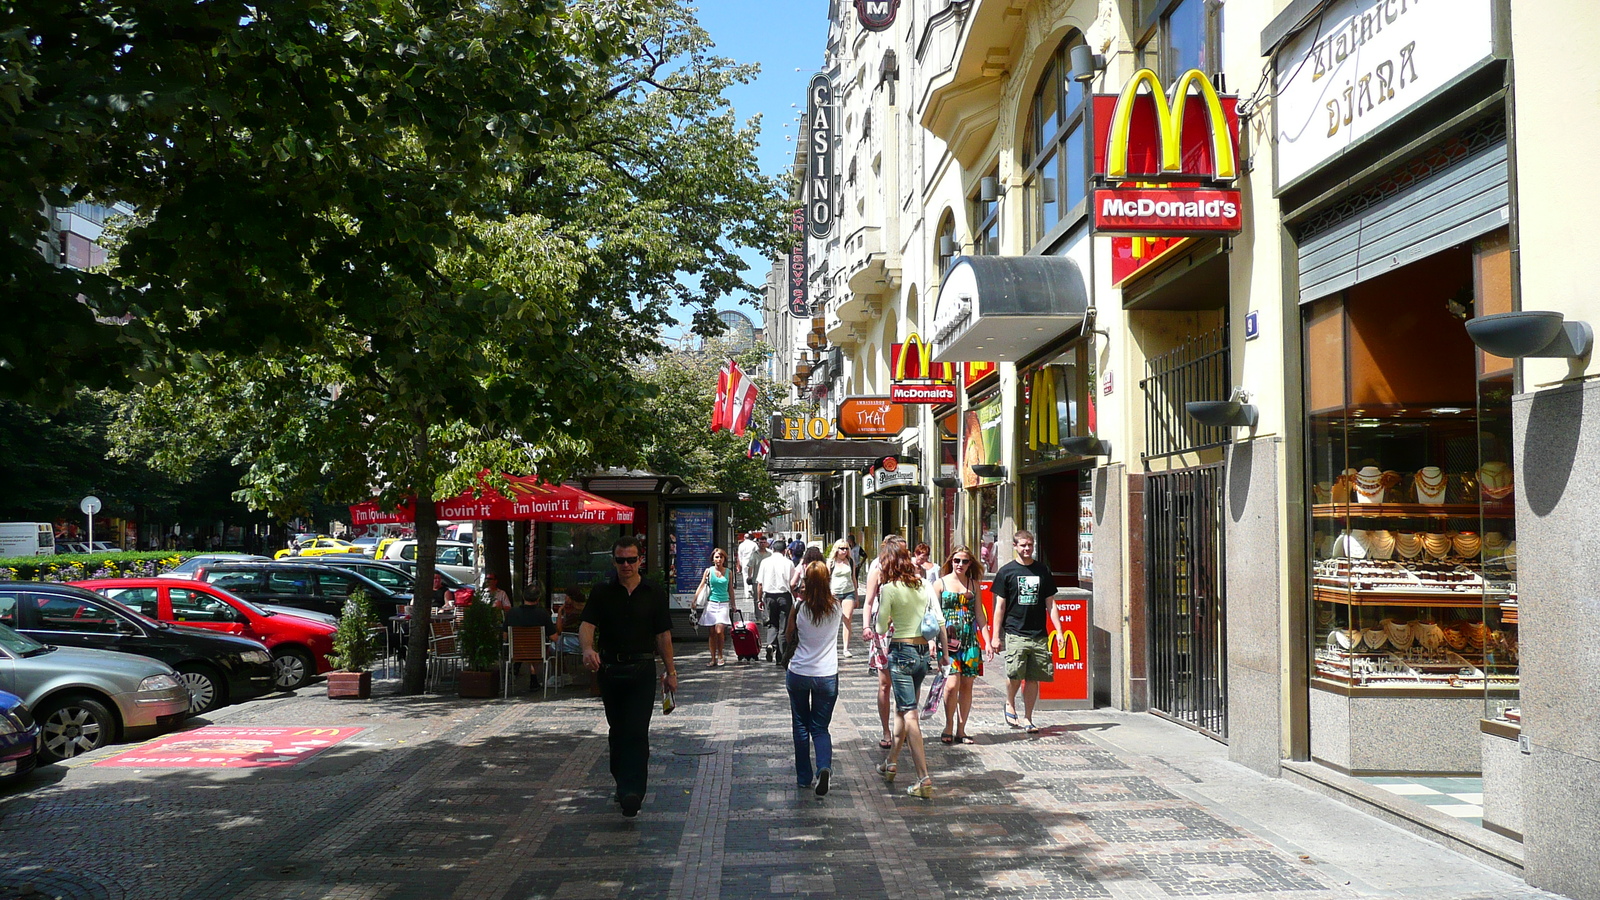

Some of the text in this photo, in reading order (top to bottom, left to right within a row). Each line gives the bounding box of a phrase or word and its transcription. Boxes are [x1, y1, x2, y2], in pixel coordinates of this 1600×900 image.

[813, 85, 829, 225] CASINO
[1102, 198, 1237, 218] McDonald's
[894, 389, 954, 398] McDonald's
[856, 409, 885, 426] THAI
[440, 504, 491, 517] lovin' it
[513, 503, 530, 514] i'm
[532, 499, 560, 513] lovin'
[562, 499, 570, 511] it
[597, 510, 606, 520] it
[1055, 662, 1076, 670] lovin'
